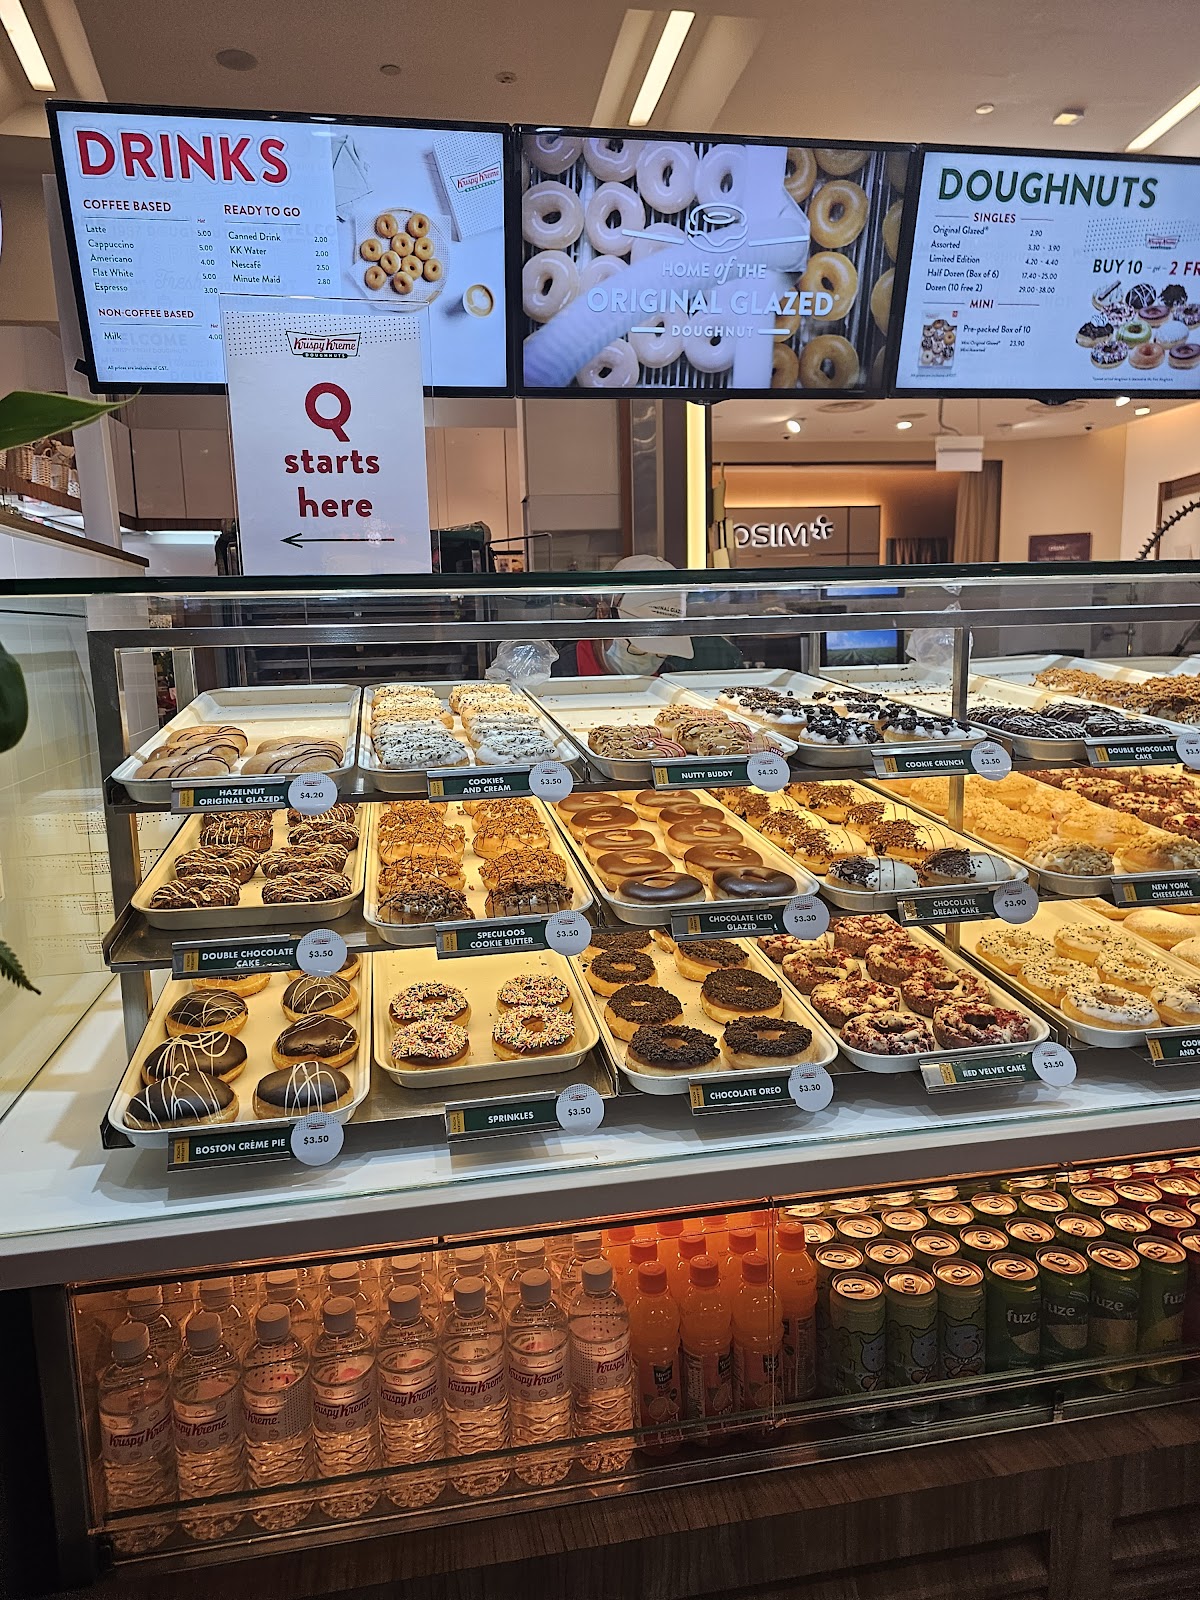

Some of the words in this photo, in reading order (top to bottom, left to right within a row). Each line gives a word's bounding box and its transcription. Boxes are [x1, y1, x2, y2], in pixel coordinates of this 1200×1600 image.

[76, 130, 288, 184] DRINKS
[938, 167, 1159, 209] DOUGHNUTS
[83, 199, 130, 211] COFFEE
[133, 201, 171, 212] BASED
[224, 204, 262, 217] READY
[264, 206, 281, 216] TO
[283, 207, 300, 217] GO
[973, 212, 1016, 224] SINGLES
[86, 224, 107, 234] Latte
[933, 225, 960, 237] Original
[228, 231, 257, 241] Canned
[259, 233, 281, 242] Drink
[88, 239, 135, 251] Cappuccino
[931, 240, 960, 249] Assorted
[230, 246, 243, 255] KK
[245, 247, 267, 256] Water
[90, 254, 133, 264] Americano
[231, 260, 262, 270] Nescafé
[929, 255, 955, 264] Limited
[957, 256, 980, 264] Edition
[92, 268, 108, 277] Flat
[110, 269, 134, 278] White
[662, 263, 709, 278] HOME
[714, 256, 734, 285] of
[737, 264, 767, 279] THE
[1093, 259, 1125, 275] BUY
[1128, 260, 1143, 275] 10
[1169, 261, 1178, 275] 2
[233, 274, 260, 284] Minute
[261, 275, 281, 284] Maid
[927, 269, 943, 278] Half
[944, 269, 965, 279] Dozen
[966, 269, 981, 279] (Box
[982, 270, 990, 278] of
[991, 270, 1000, 279] 6)
[94, 282, 128, 293] Espresso
[925, 283, 946, 292] Dozen
[947, 283, 959, 293] (10
[960, 283, 975, 292] free
[976, 283, 983, 293] 2)
[587, 287, 722, 315] ORIGINAL
[970, 299, 994, 309] MINI
[98, 308, 162, 318] NON-COFFEE
[163, 309, 194, 319] BASED
[671, 325, 754, 337] DOUGHNUT
[963, 325, 1000, 335] Pre-packed
[1001, 326, 1013, 334] Box
[1015, 326, 1022, 334] of
[1023, 326, 1031, 334] 10
[104, 332, 122, 341] Milk
[294, 338, 325, 352] Krispy
[325, 338, 356, 351] Kreme
[304, 382, 352, 442] Q
[284, 450, 380, 474] starts
[297, 486, 373, 517] here
[733, 522, 810, 549] OSIM
[770, 747, 784, 757] NEW
[1108, 746, 1134, 754] DOUBLE
[1135, 745, 1175, 753] CHOCOLATE
[905, 760, 933, 768] COOKIE
[934, 758, 964, 767] CRUNCH
[980, 758, 1001, 766] $3.50
[681, 770, 706, 779] NUTTY
[707, 769, 733, 779] BUDDY
[462, 786, 480, 794] AND
[482, 784, 511, 793] CREAM
[540, 778, 562, 786] $3.50
[468, 777, 504, 786] COOKIES
[199, 796, 244, 806] ORIGINAL
[300, 791, 324, 799] $4.20
[219, 788, 265, 797] HAZELNUT
[1151, 883, 1167, 891] NEW
[1169, 882, 1190, 890] YORK
[1151, 890, 1194, 899] CHEESECAKE
[933, 898, 976, 907] CHOCOLATE
[933, 907, 958, 916] DREAM
[960, 906, 980, 914] CAKE
[1004, 899, 1027, 907] $3.90
[709, 914, 753, 923] CHOCOLATE
[755, 913, 773, 921] ICED
[726, 922, 757, 931] GLAZED
[794, 914, 816, 923] $3.30
[470, 938, 502, 948] COOKIE
[504, 936, 534, 947] BUTTER
[556, 929, 579, 938] $3.50
[477, 928, 525, 940] SPECULOOS
[202, 951, 238, 960] DOUBLE
[241, 948, 294, 958] CHOCOLATE
[236, 959, 260, 968] CAKE
[308, 950, 333, 958] $3.50
[1180, 1048, 1195, 1056] AND
[963, 1068, 978, 1077] RED
[980, 1066, 1005, 1076] VELVET
[1006, 1064, 1027, 1074] CAKE
[1043, 1060, 1064, 1069] $3.50
[709, 1088, 756, 1100] CHOCOLATE
[758, 1086, 782, 1096] OREO
[799, 1083, 821, 1093] $3.30
[487, 1111, 534, 1124] SPRINKLES
[567, 1107, 591, 1116] $3.50
[195, 1144, 236, 1155] BOSTON
[239, 1139, 270, 1151] CRÈME
[271, 1138, 286, 1147] PIE
[303, 1135, 329, 1145] $3.50
[1006, 1310, 1037, 1323] fuze
[596, 1352, 626, 1373] Krispy
[449, 1378, 478, 1396] Krispy
[109, 1430, 146, 1448] Krispy
